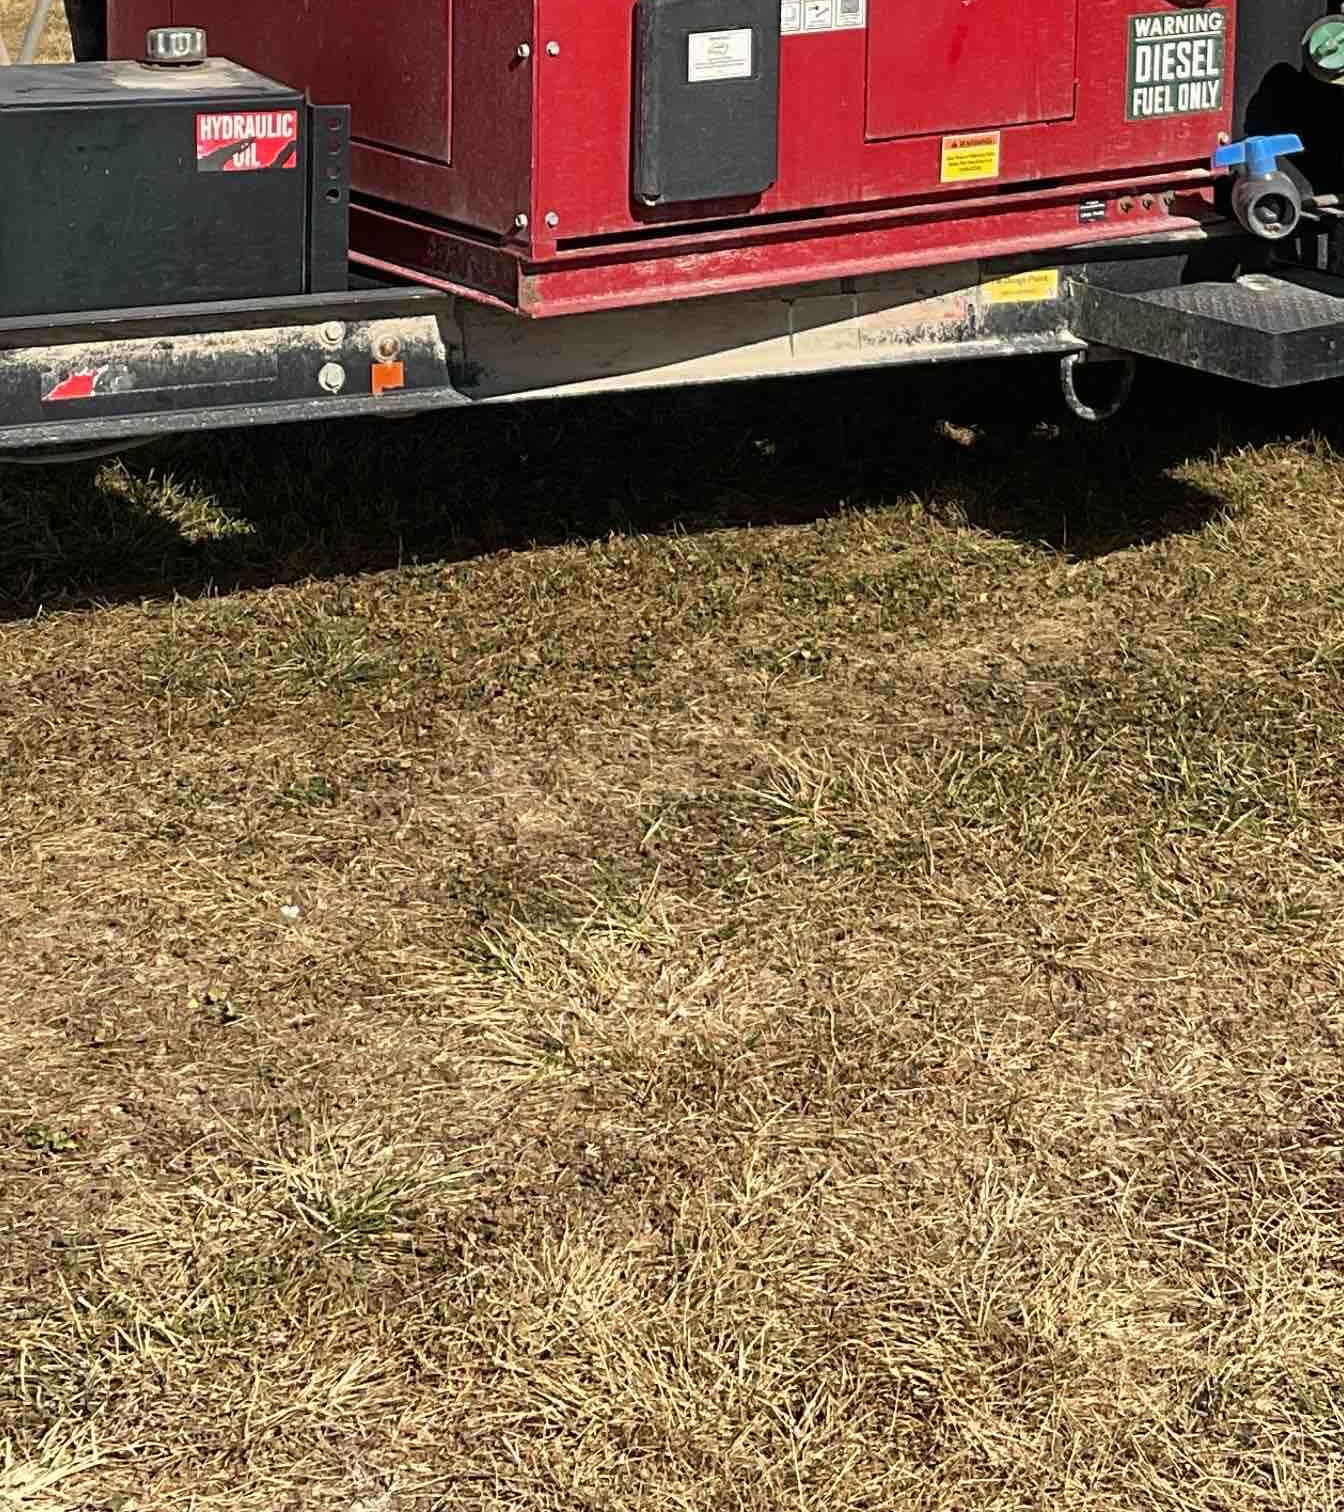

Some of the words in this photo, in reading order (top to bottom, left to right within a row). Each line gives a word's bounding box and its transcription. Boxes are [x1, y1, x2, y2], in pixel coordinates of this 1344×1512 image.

[1135, 12, 1223, 37] WARNING
[1136, 39, 1219, 83] DIESEL
[1133, 85, 1174, 116] FUEL
[1178, 80, 1219, 111] ONLY
[200, 112, 293, 140] HYDRAULIC
